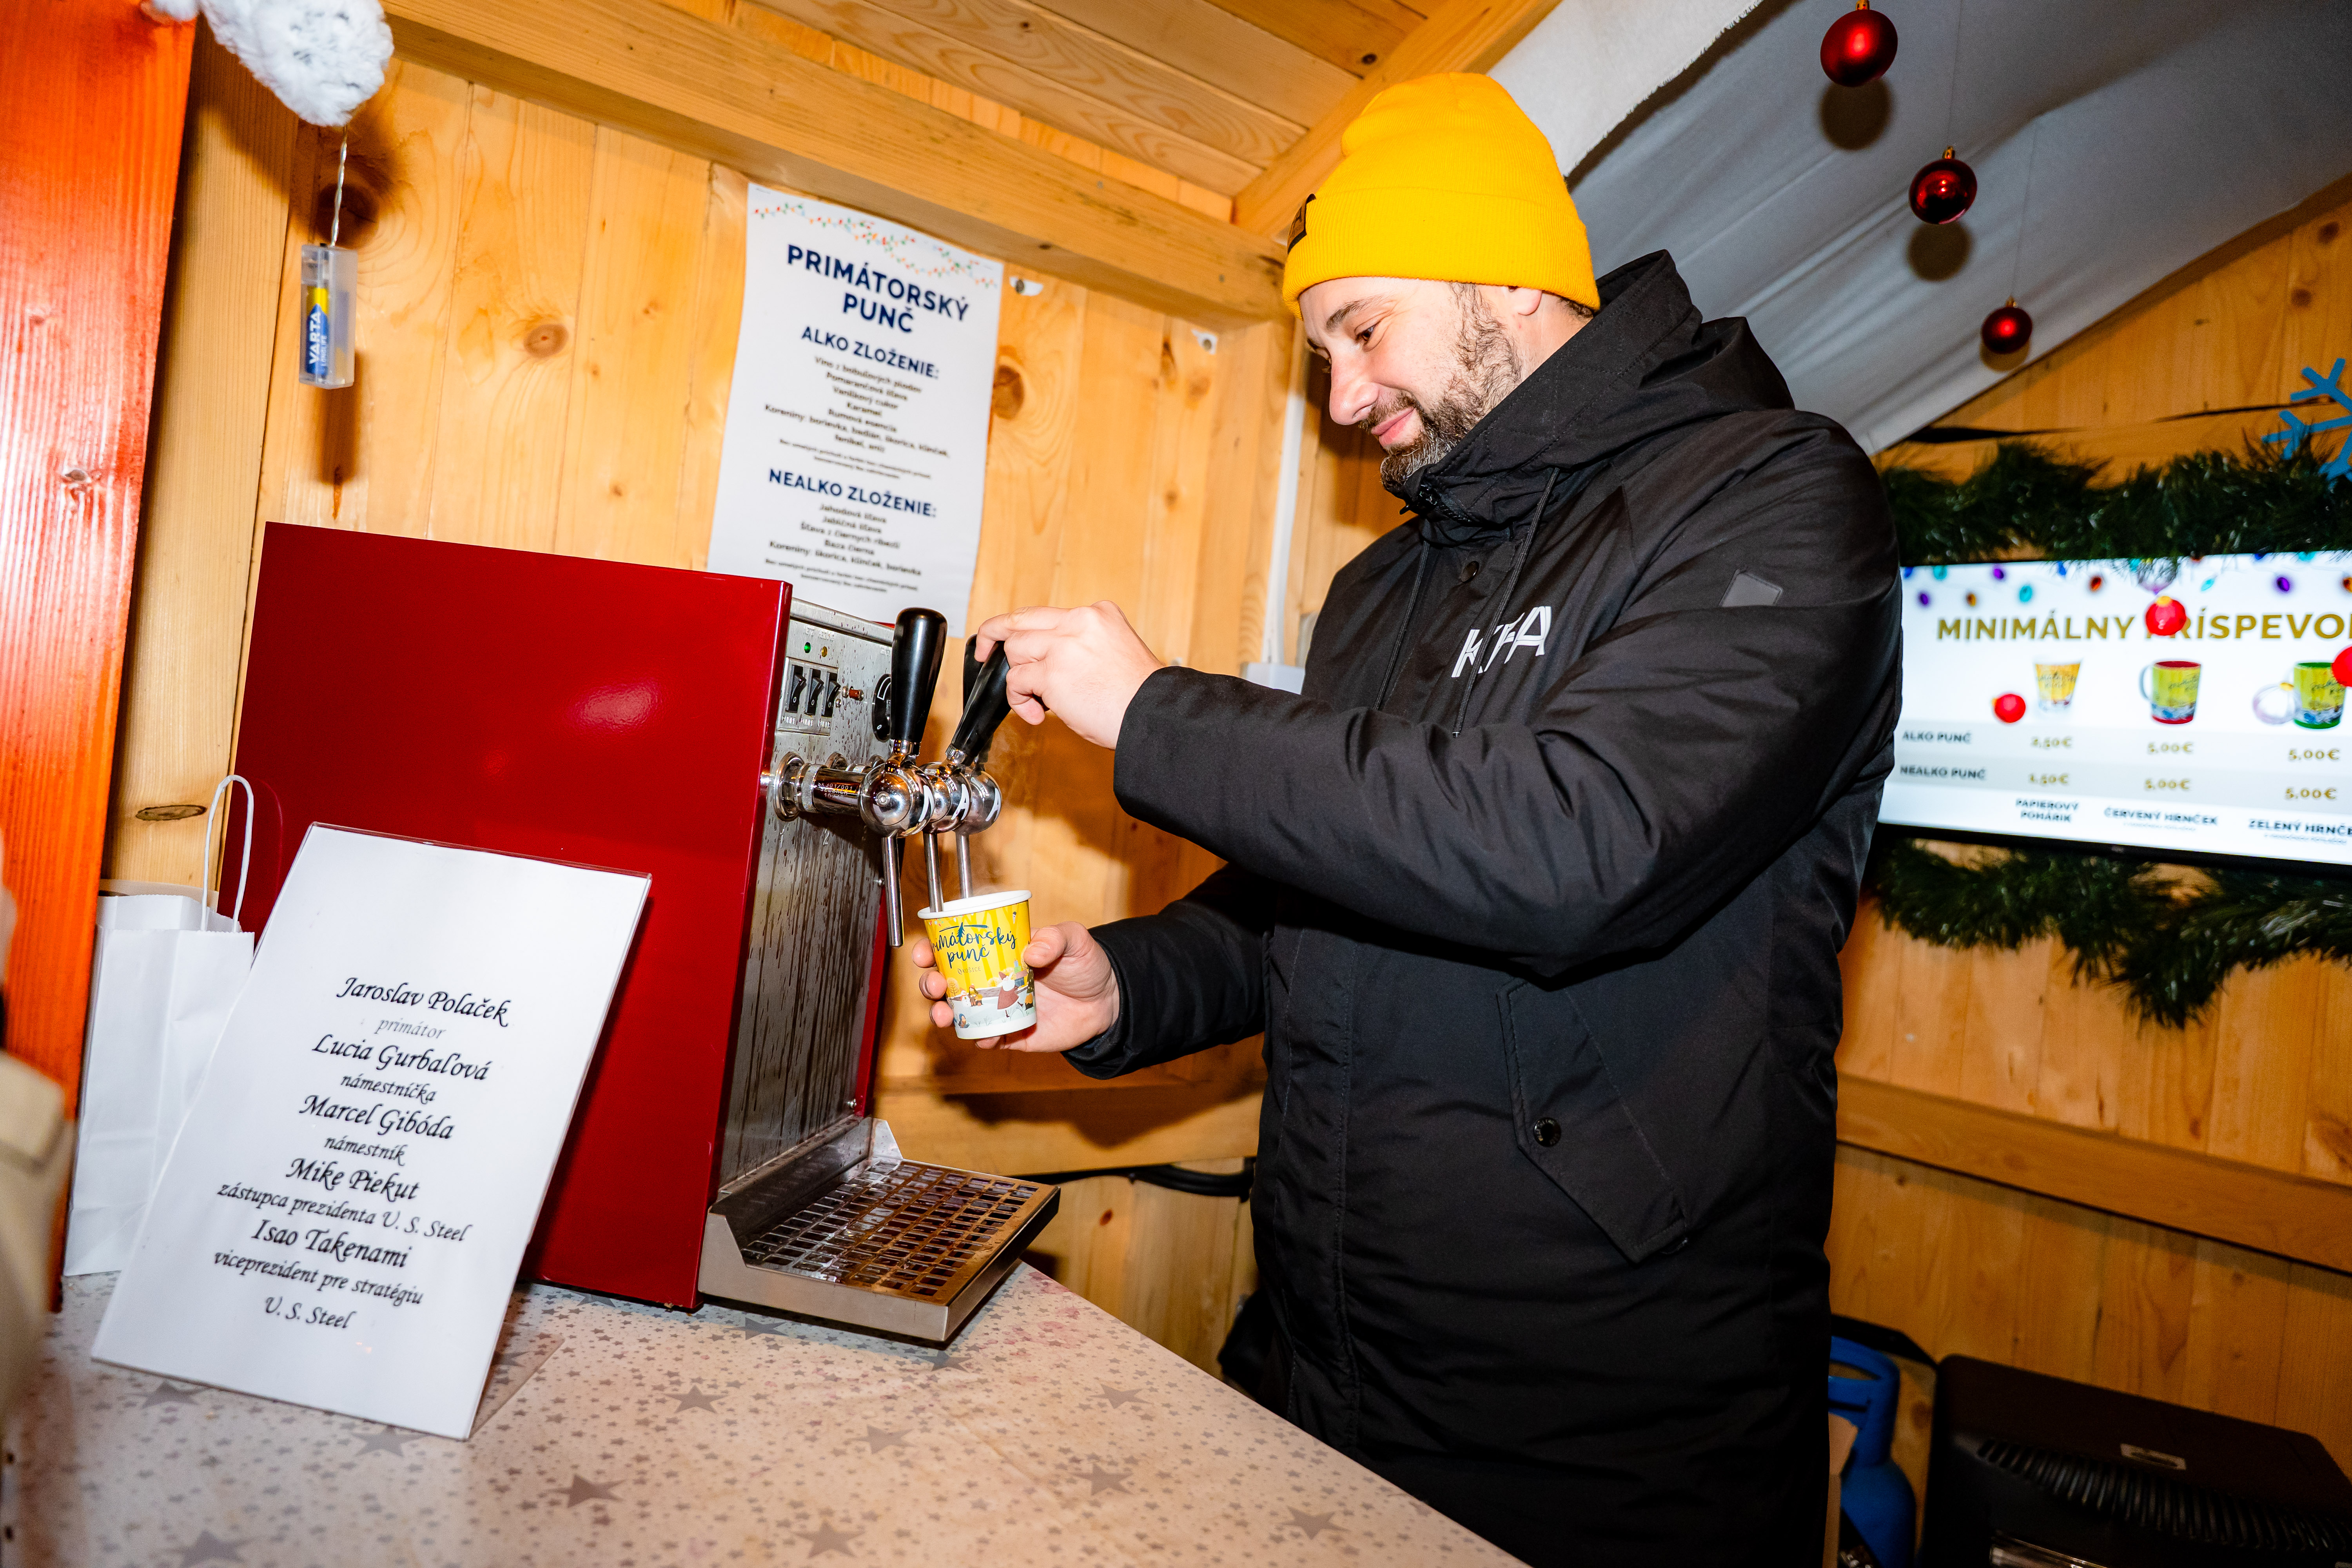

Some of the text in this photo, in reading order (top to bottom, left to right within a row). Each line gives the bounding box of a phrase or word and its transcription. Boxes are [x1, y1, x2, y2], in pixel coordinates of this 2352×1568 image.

[788, 244, 969, 321] PRIMÁTORSKÝ
[843, 292, 914, 333] PUNČ
[309, 312, 321, 365] VARTA
[802, 326, 939, 379] ALKO ZLOŽENIE:
[769, 468, 936, 517] NEALKO ZLOŽENIE:
[1937, 606, 2352, 640] MINIMÁLNY RÍSPEVO
[1902, 730, 1934, 742] ALKO
[1900, 764, 1948, 777] NEALKO
[2288, 748, 2340, 762] 5,00€
[2015, 798, 2079, 811] PAPIEROVÝ
[2284, 787, 2337, 802] 5,00€
[2249, 818, 2301, 831] ZELENÝ
[947, 944, 990, 969] punč
[336, 977, 512, 1027] Jaroslav Polaček
[374, 1020, 446, 1039] primátor
[312, 1034, 493, 1080] Lucia Gurbaľová
[341, 1073, 437, 1105] námestníčka
[299, 1095, 455, 1139] Marcel Gibóda
[324, 1135, 408, 1166] námestník
[285, 1158, 419, 1203] Mike Piekut
[217, 1182, 473, 1242] zástupca prezidenta U. S. Steel
[251, 1219, 412, 1268] Isao Takenami
[214, 1250, 423, 1307] viceprezident pre stratégiu
[265, 1296, 357, 1329] U. S. Steel
